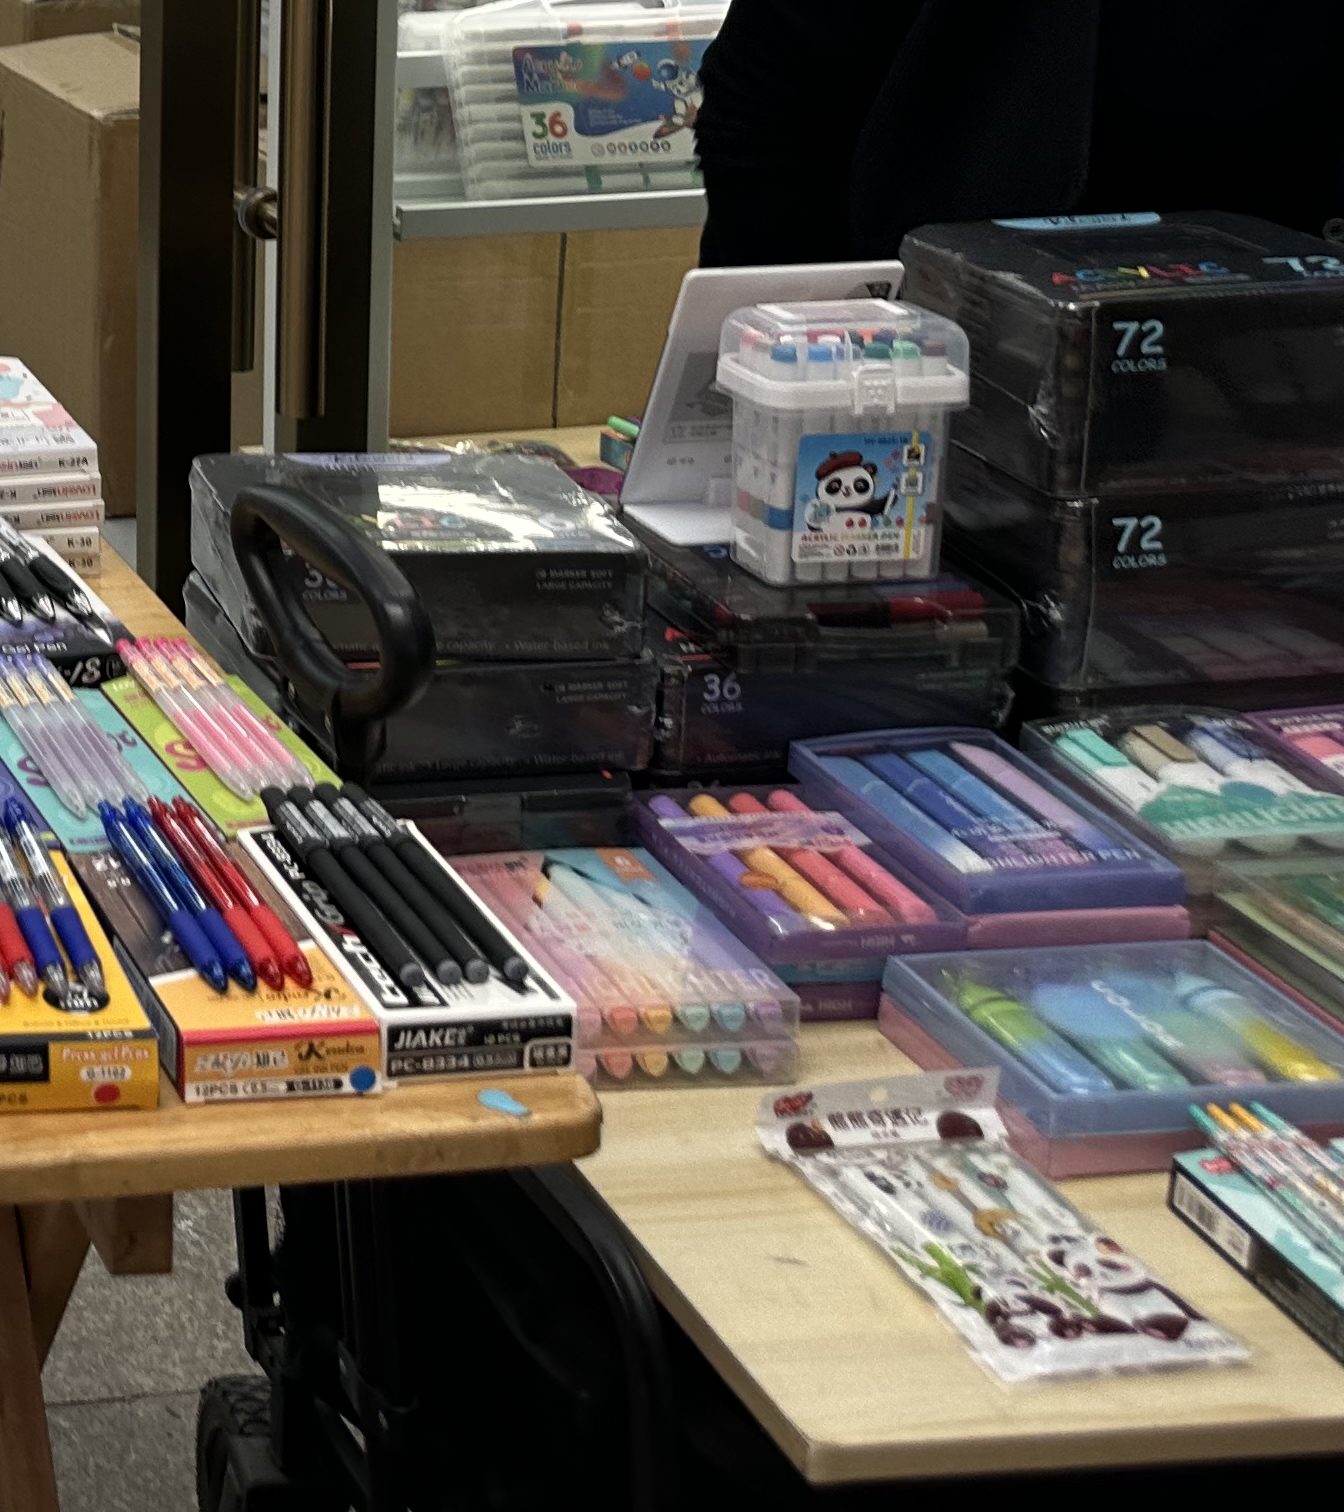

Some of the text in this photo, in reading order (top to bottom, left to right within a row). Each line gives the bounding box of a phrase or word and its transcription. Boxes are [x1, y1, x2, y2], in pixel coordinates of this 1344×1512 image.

[530, 110, 568, 140] 36
[533, 140, 572, 155] colors
[1112, 319, 1165, 357] 72
[1112, 357, 1167, 373] COLORS
[1112, 515, 1165, 552] 72
[1112, 552, 1167, 569] COLORS
[703, 672, 742, 701] 36
